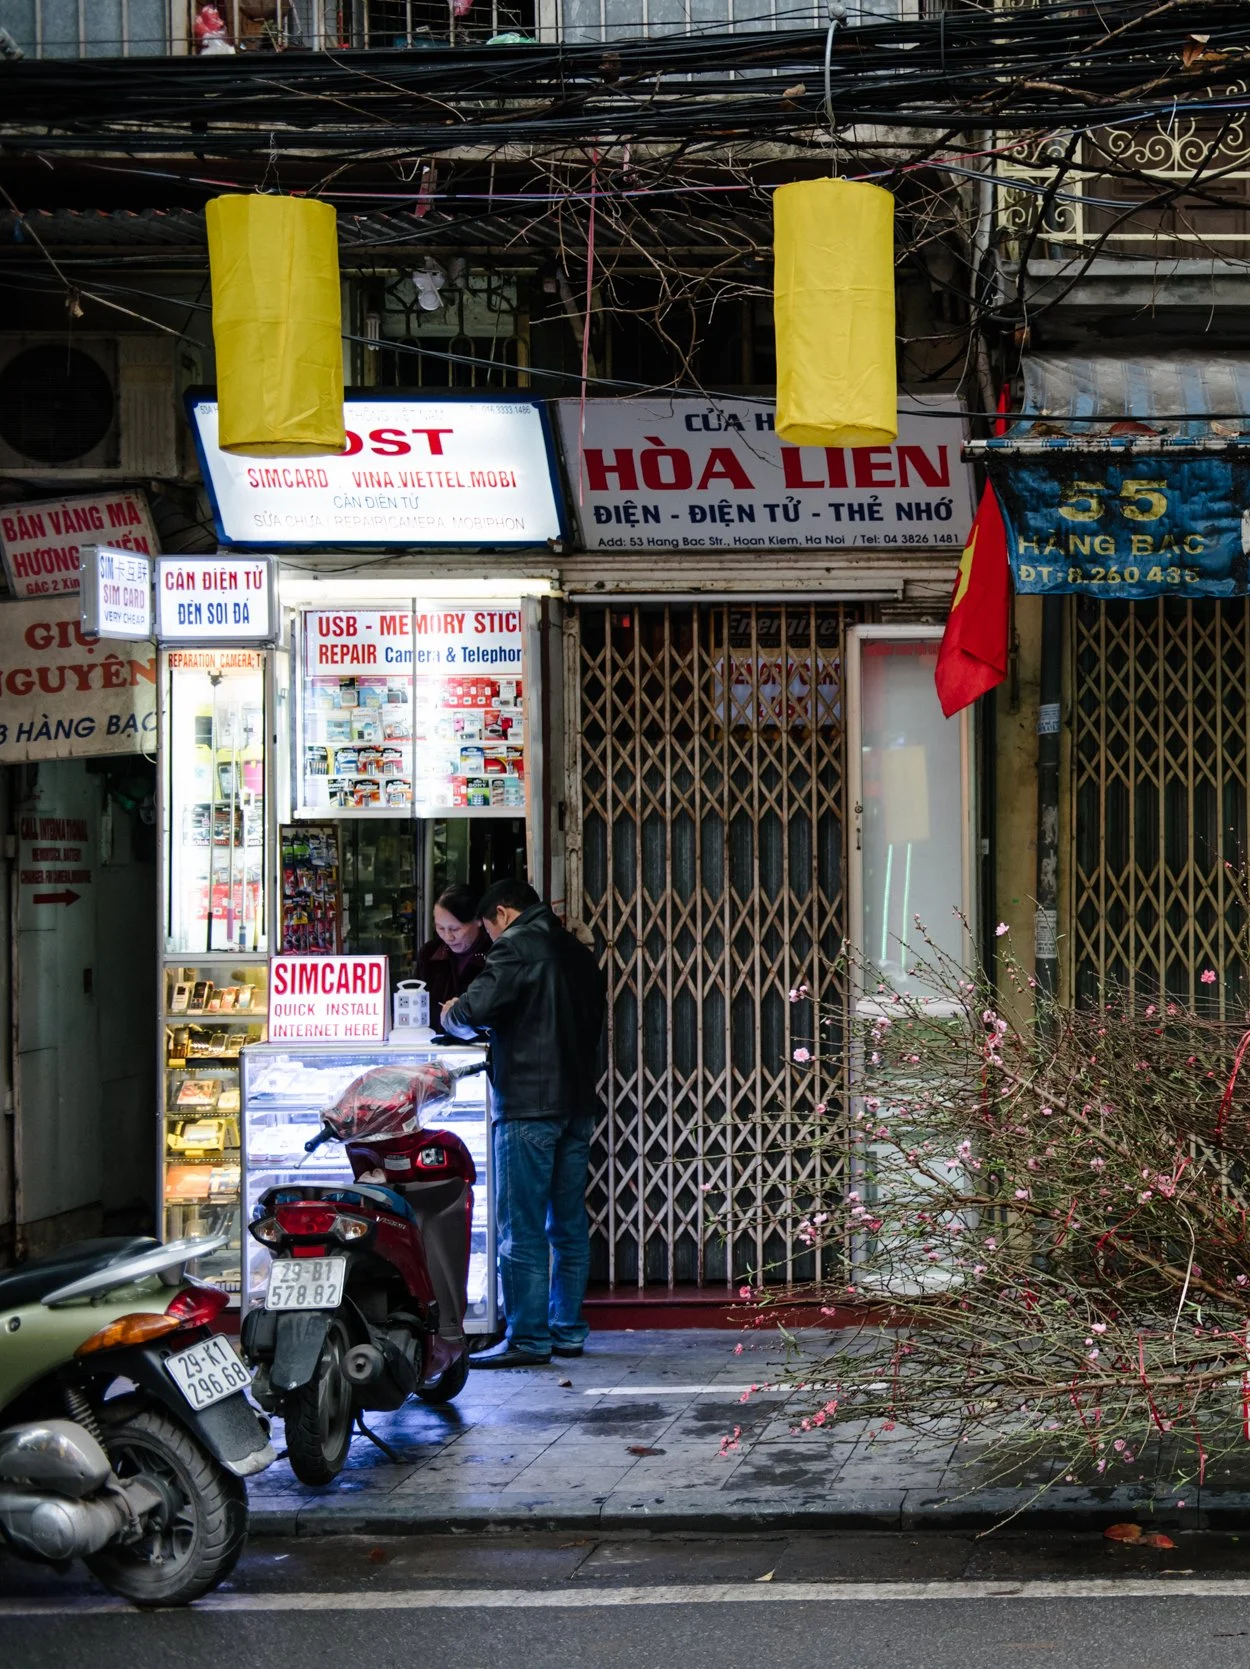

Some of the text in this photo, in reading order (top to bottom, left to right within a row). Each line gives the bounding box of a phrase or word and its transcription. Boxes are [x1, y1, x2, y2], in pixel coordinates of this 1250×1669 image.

[685, 408, 745, 432] CỬA
[584, 436, 755, 490] HÒA
[247, 468, 330, 488] SIMCARD
[1, 496, 142, 542] BÁN VÀNG MÃ
[594, 500, 661, 528] ĐIỆN
[688, 500, 756, 528] ĐIỆN
[764, 496, 801, 523] TỬ
[829, 496, 883, 522] THẺ
[896, 498, 953, 521] NHỚ
[598, 537, 626, 547] Add:
[629, 537, 643, 547] 53
[647, 537, 679, 548] Hang
[682, 537, 705, 546] Bac
[733, 536, 765, 546] Hoan
[768, 535, 802, 546] Kiem,
[805, 535, 821, 545] Ha
[825, 535, 845, 545] Noi
[860, 534, 880, 544] Tel:
[884, 534, 898, 544] 04
[901, 534, 929, 544] 3826
[932, 534, 959, 544] 1481
[1018, 529, 1204, 559] HÀNG BẠC
[13, 546, 80, 578] HƯƠNG
[100, 556, 114, 580] SIM
[51, 580, 59, 591] 2
[165, 568, 195, 591] CÂN
[244, 565, 263, 590] TỬ
[103, 585, 145, 609] SIM CARD
[104, 610, 145, 625] VERY CHEAP
[178, 598, 250, 625] ĐÈN SOI ĐÁ
[318, 615, 358, 637] USB
[380, 613, 465, 636] MEMORY
[474, 612, 521, 634] STIC
[168, 653, 215, 668] REPARATION
[319, 644, 377, 664] REPAIR
[385, 646, 441, 664] Camera
[446, 648, 456, 663] &
[0, 653, 157, 697] GUYÊN
[16, 713, 96, 743] HÀNG
[274, 962, 382, 995] SIMCARD
[274, 1003, 379, 1017] QUICK INSTALL
[273, 1023, 379, 1037] INTERNET HERE
[280, 1261, 333, 1283] 29-B1
[271, 1284, 337, 1306] 578.82
[178, 1341, 228, 1379] 29-K1
[188, 1362, 246, 1405] 296.68
